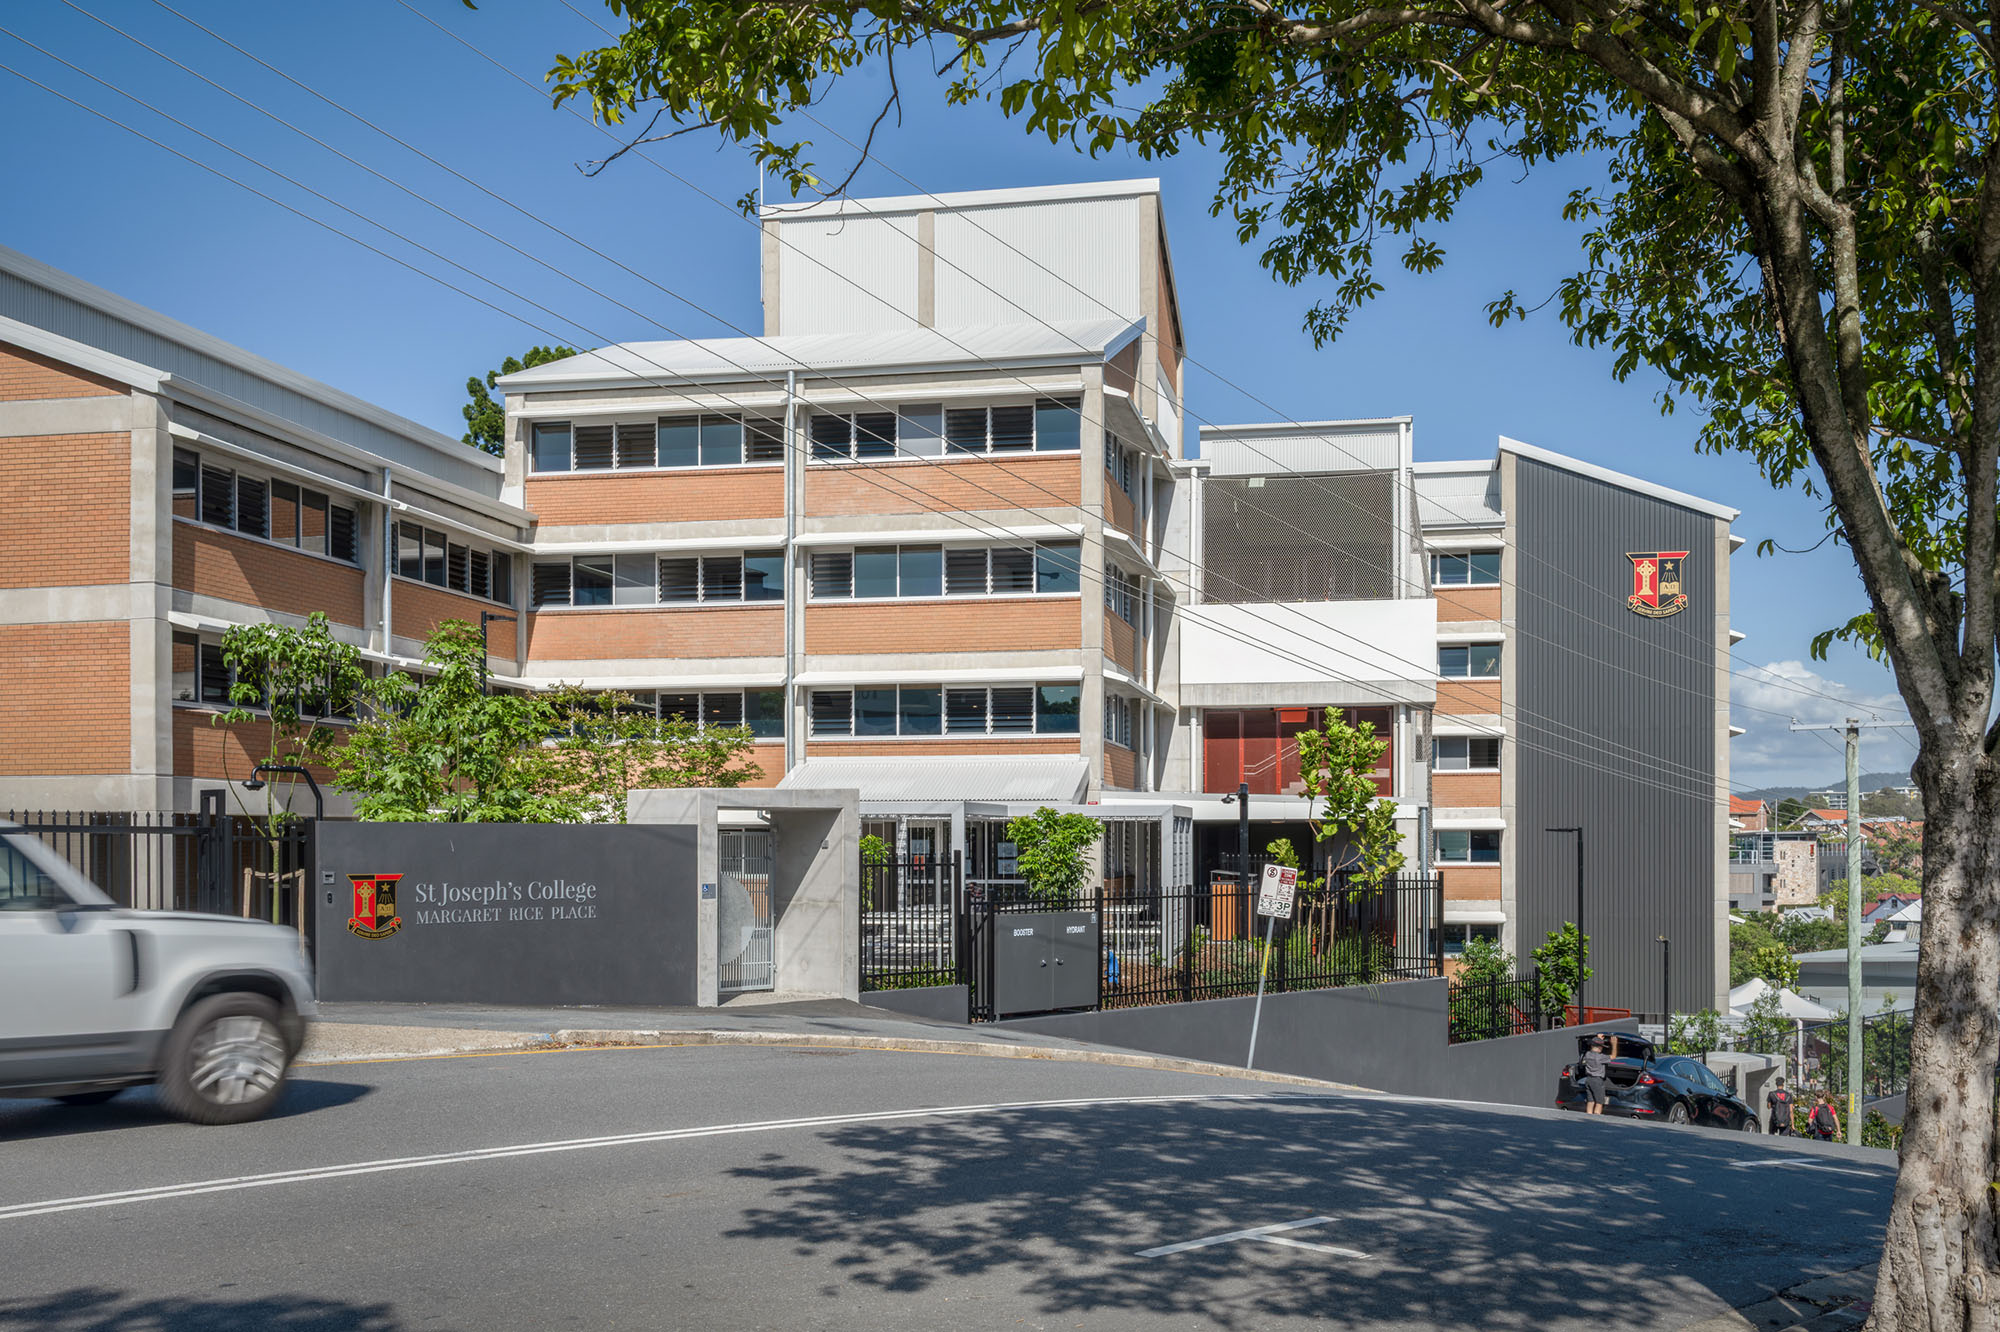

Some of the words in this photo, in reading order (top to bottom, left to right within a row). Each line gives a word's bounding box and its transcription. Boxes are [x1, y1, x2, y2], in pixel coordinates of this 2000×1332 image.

[415, 883, 437, 903] St
[438, 880, 522, 907] Joseph's
[528, 879, 597, 903] College
[1276, 901, 1290, 911] 3P
[416, 907, 502, 925] MARGARET
[509, 906, 544, 921] RICE
[551, 905, 597, 920] PLACE
[1013, 928, 1034, 937] BOOSTER
[1066, 925, 1086, 934] HYDRANT
